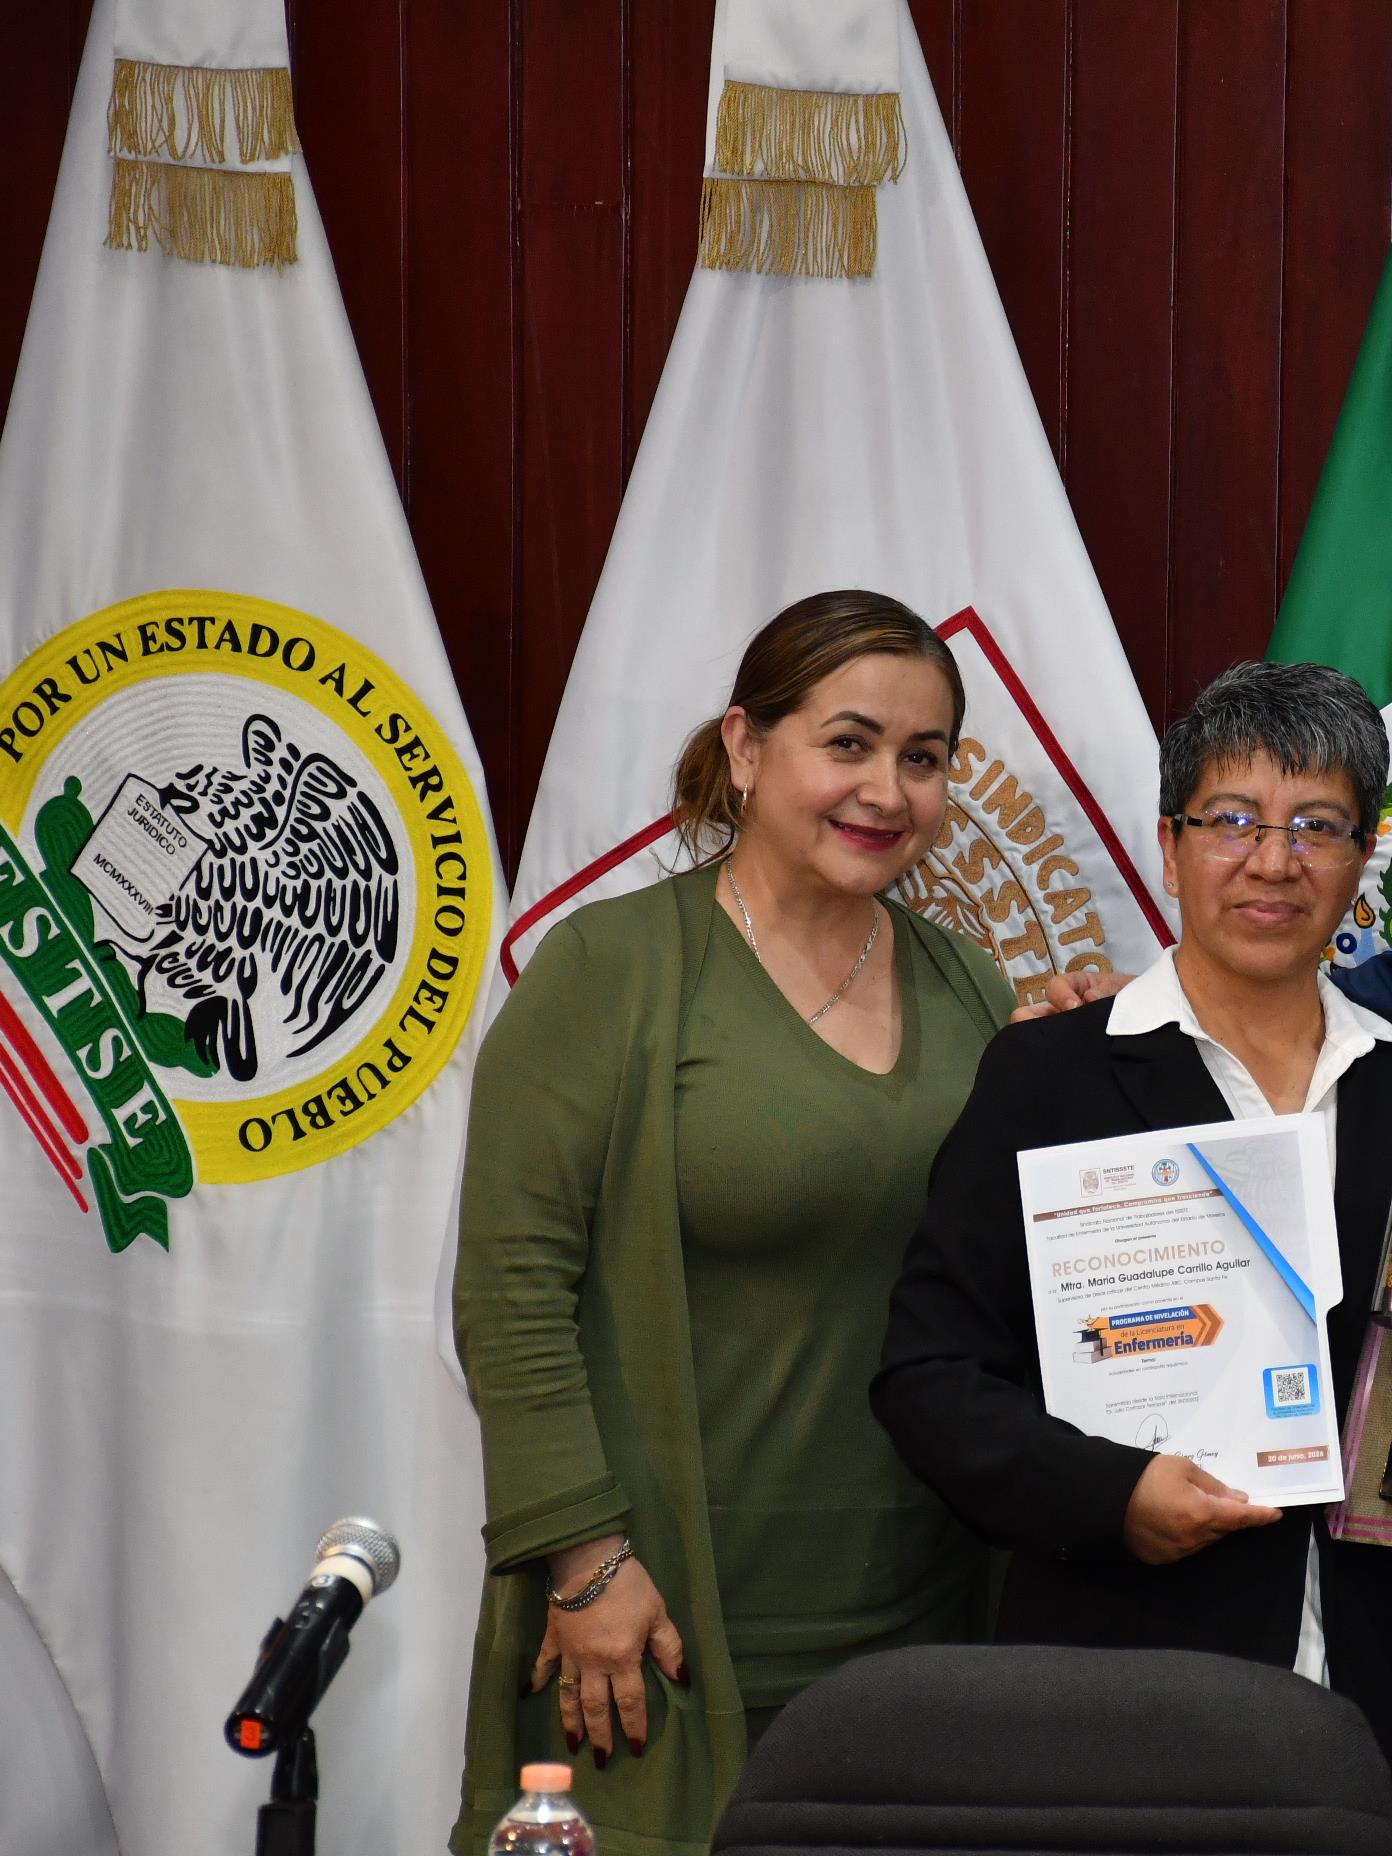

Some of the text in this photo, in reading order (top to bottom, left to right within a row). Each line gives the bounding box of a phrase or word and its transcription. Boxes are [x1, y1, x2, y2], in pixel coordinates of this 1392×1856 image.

[127, 808, 176, 855] JURIDICO
[135, 793, 188, 848] ESTATUTO
[0, 617, 467, 1152] POR UN ESTADO AL SERVICIO DEL PUEBLO
[93, 853, 154, 916] MCMXXXVIII
[1051, 1240, 1226, 1278] RECONOCIMIENTO
[1060, 1281, 1085, 1292] Mtra.
[1118, 1268, 1174, 1282] Guadalupe
[1178, 1262, 1213, 1275] Carrillo
[1216, 1258, 1250, 1272] Aguilar
[1112, 1308, 1190, 1326] PROGRAMA DE NIVELACIÓN
[1136, 1324, 1175, 1336] Licenciatura
[1114, 1331, 1194, 1354] Enfermería
